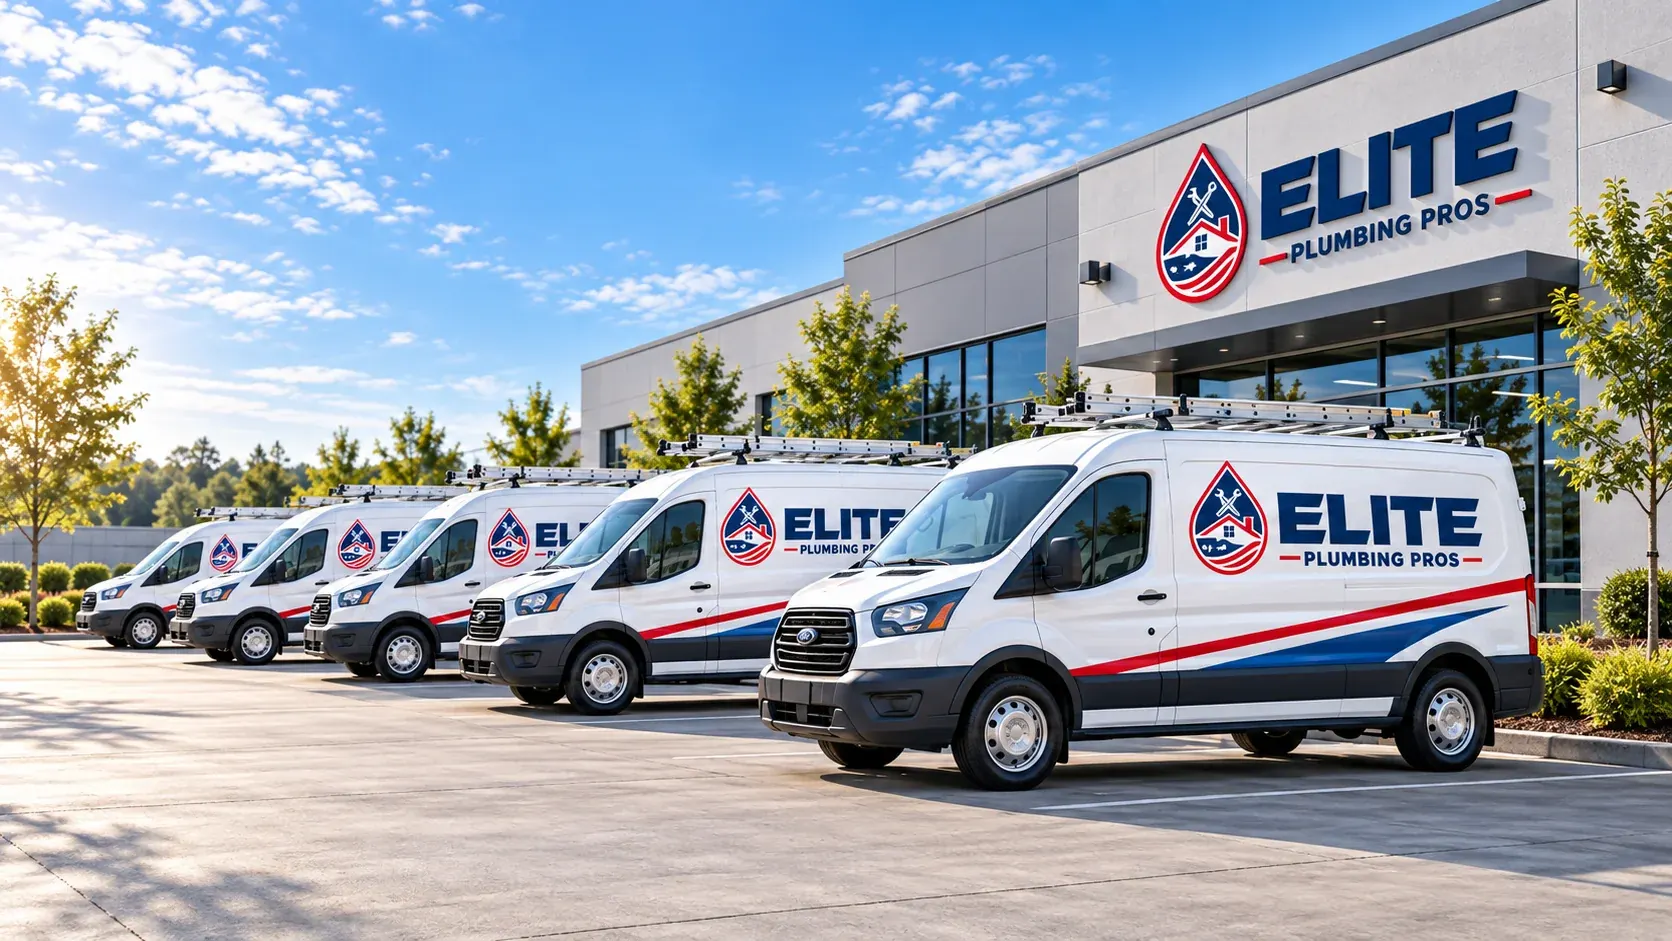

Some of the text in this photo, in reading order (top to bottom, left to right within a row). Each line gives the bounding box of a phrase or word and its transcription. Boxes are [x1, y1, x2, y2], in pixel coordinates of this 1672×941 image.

[1261, 90, 1518, 241] ELITE
[1291, 193, 1490, 263] PLUMBING PROS
[1277, 492, 1482, 547] ELITE
[800, 544, 858, 555] PLUMBING
[1304, 551, 1459, 567] PLUMBING PROS
